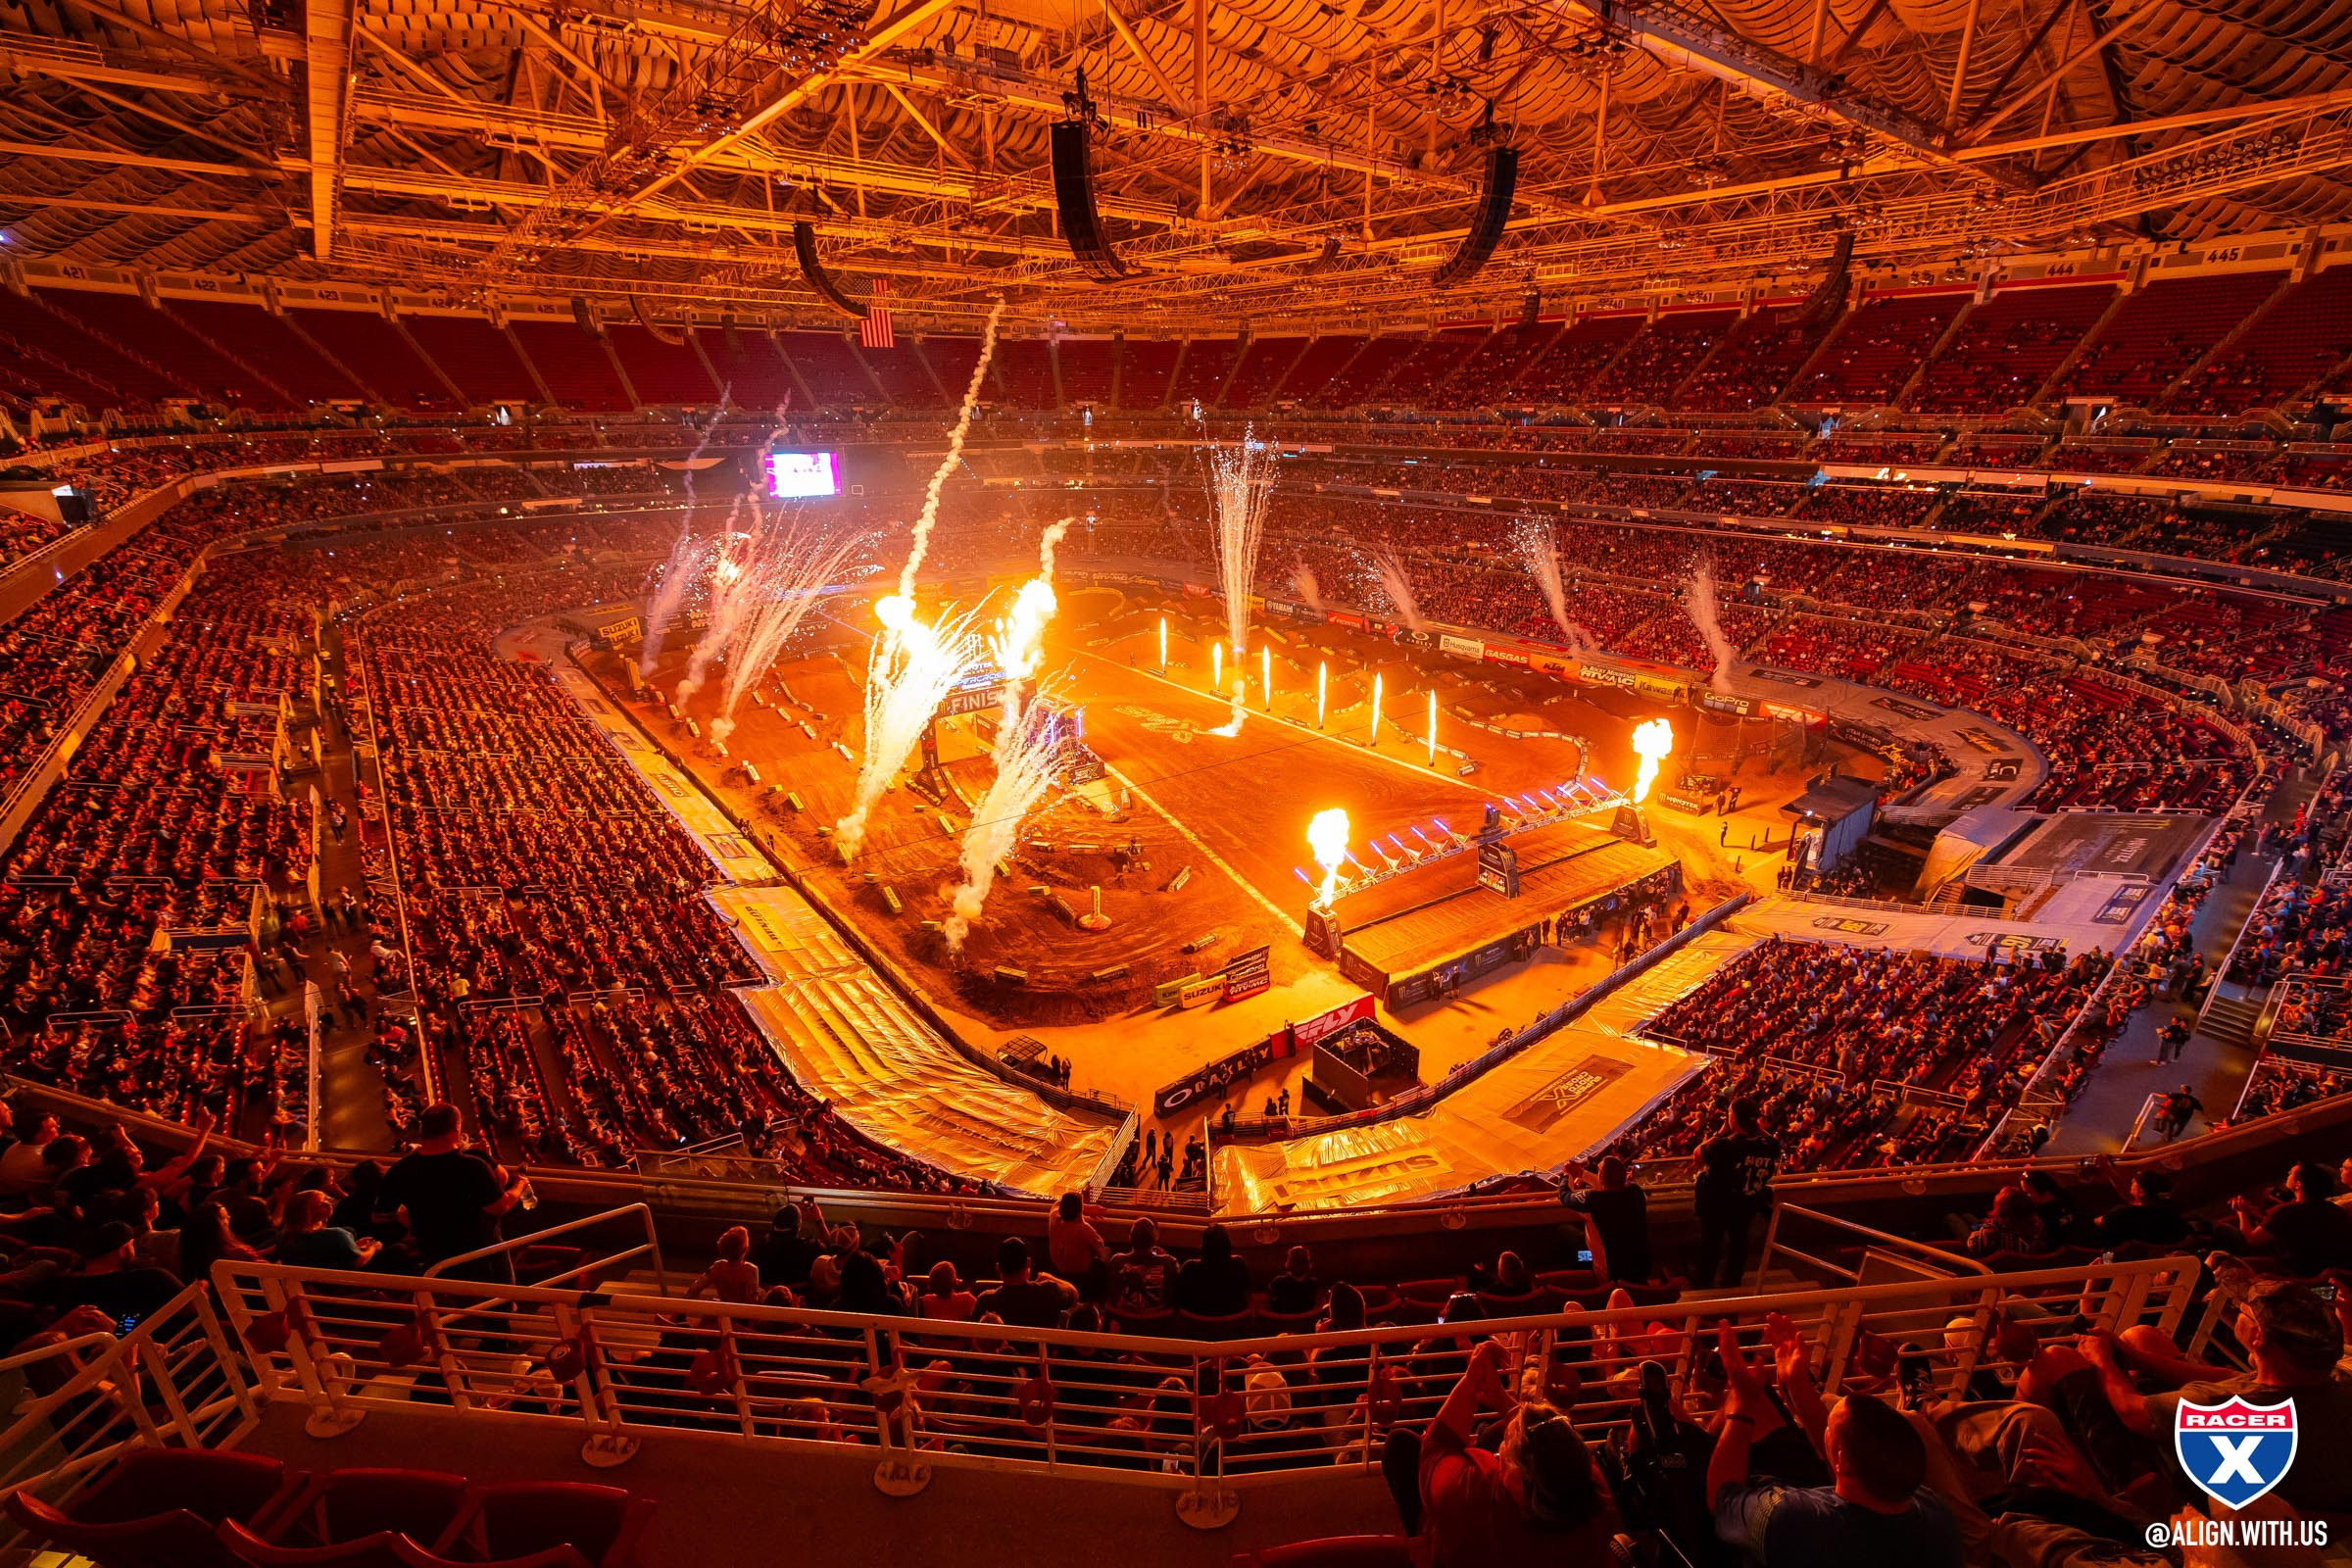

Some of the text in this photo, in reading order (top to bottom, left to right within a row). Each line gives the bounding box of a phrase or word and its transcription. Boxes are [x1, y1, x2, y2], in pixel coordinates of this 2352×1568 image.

[2207, 247, 2239, 263] 445
[63, 266, 85, 279] 421
[2047, 263, 2075, 276] 444
[194, 279, 217, 291] 422
[601, 618, 637, 636] SUZUKI
[1336, 618, 1360, 628] HONDA
[1449, 640, 1480, 654] Husqvarna
[1484, 649, 1528, 663] GASGAS
[1543, 662, 1566, 673] KTM
[951, 689, 1006, 713] FINIS
[1704, 692, 1749, 708] GoPro
[1183, 982, 1226, 1001] SUZUKI
[1560, 1071, 1589, 1090] CROSS
[1568, 1073, 1594, 1093] MOTO
[1575, 1075, 1602, 1096] SUPER
